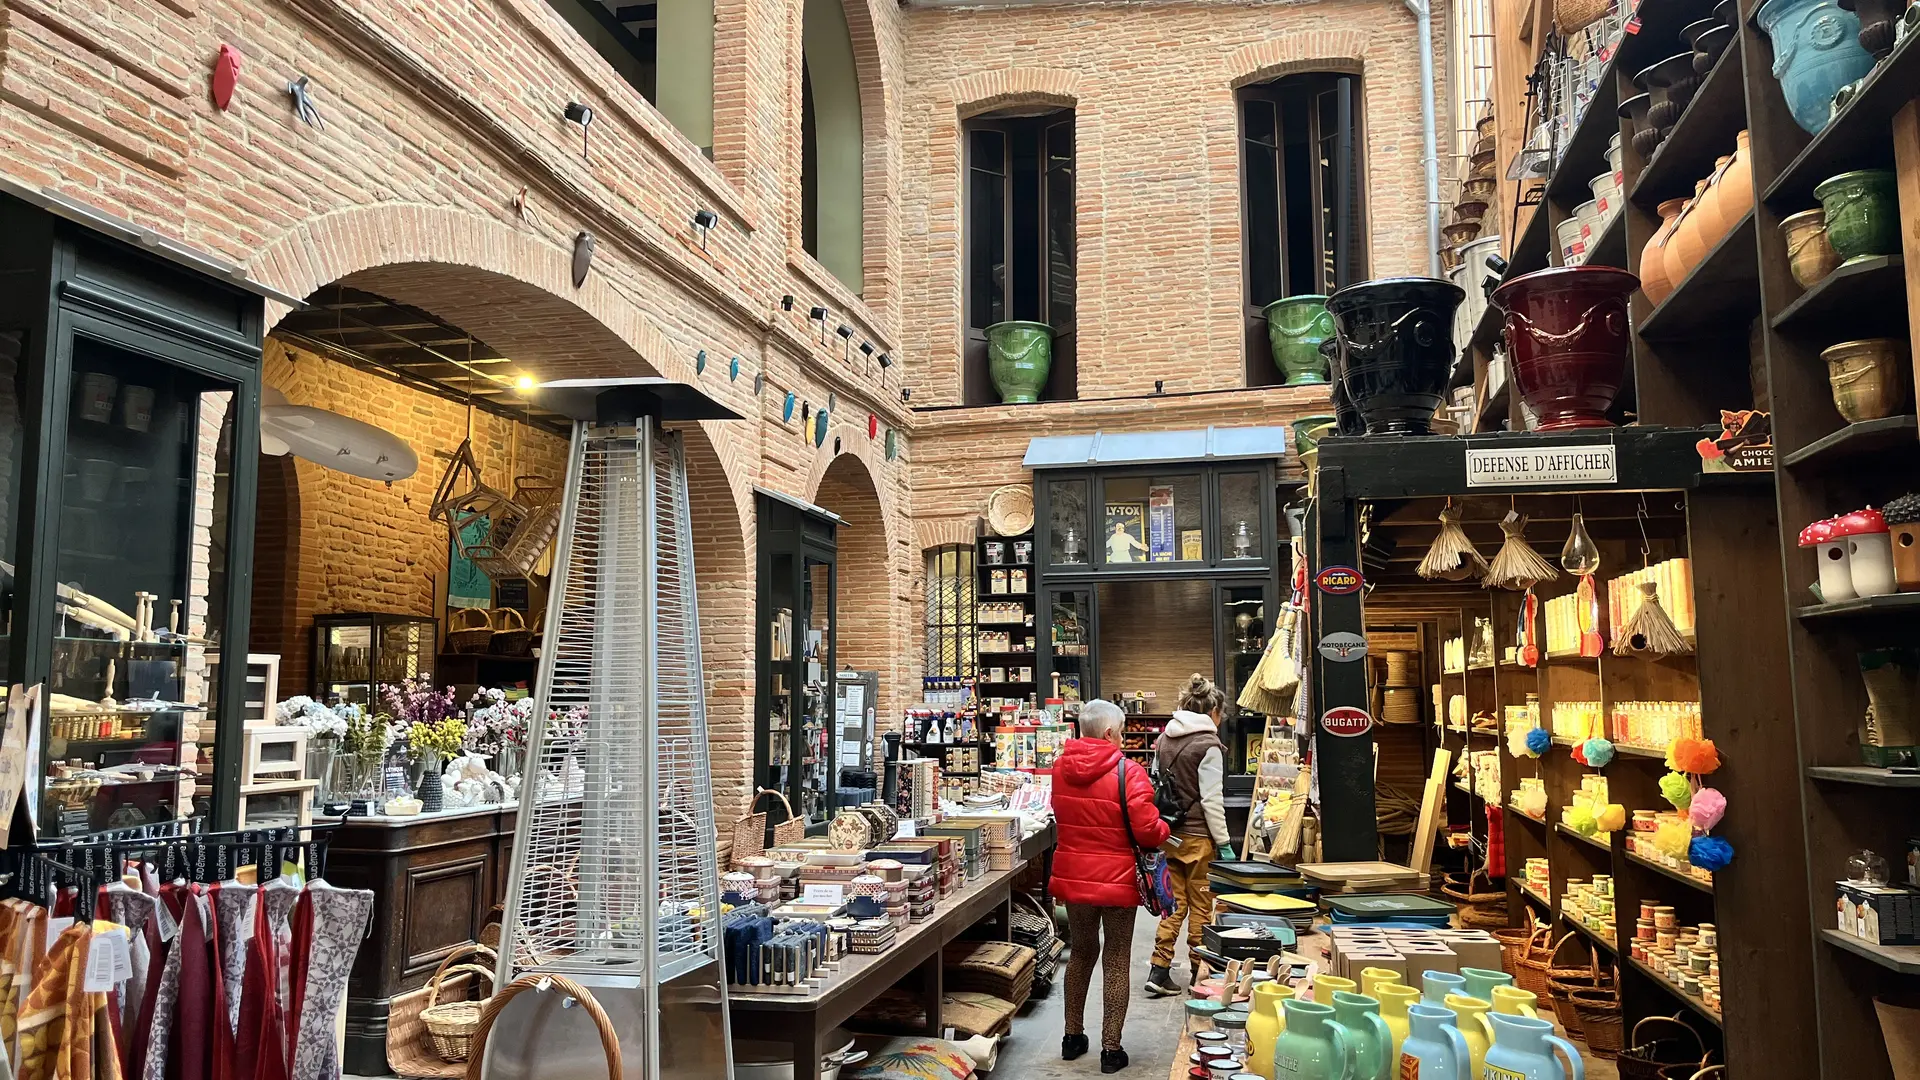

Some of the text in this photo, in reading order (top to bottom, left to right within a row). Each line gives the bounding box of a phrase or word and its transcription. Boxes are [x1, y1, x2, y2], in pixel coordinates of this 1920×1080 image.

[1473, 453, 1611, 474] DEFENSE D'AFFICHER
[1322, 576, 1356, 585] RICARD
[1324, 717, 1367, 727] BUGATTI
